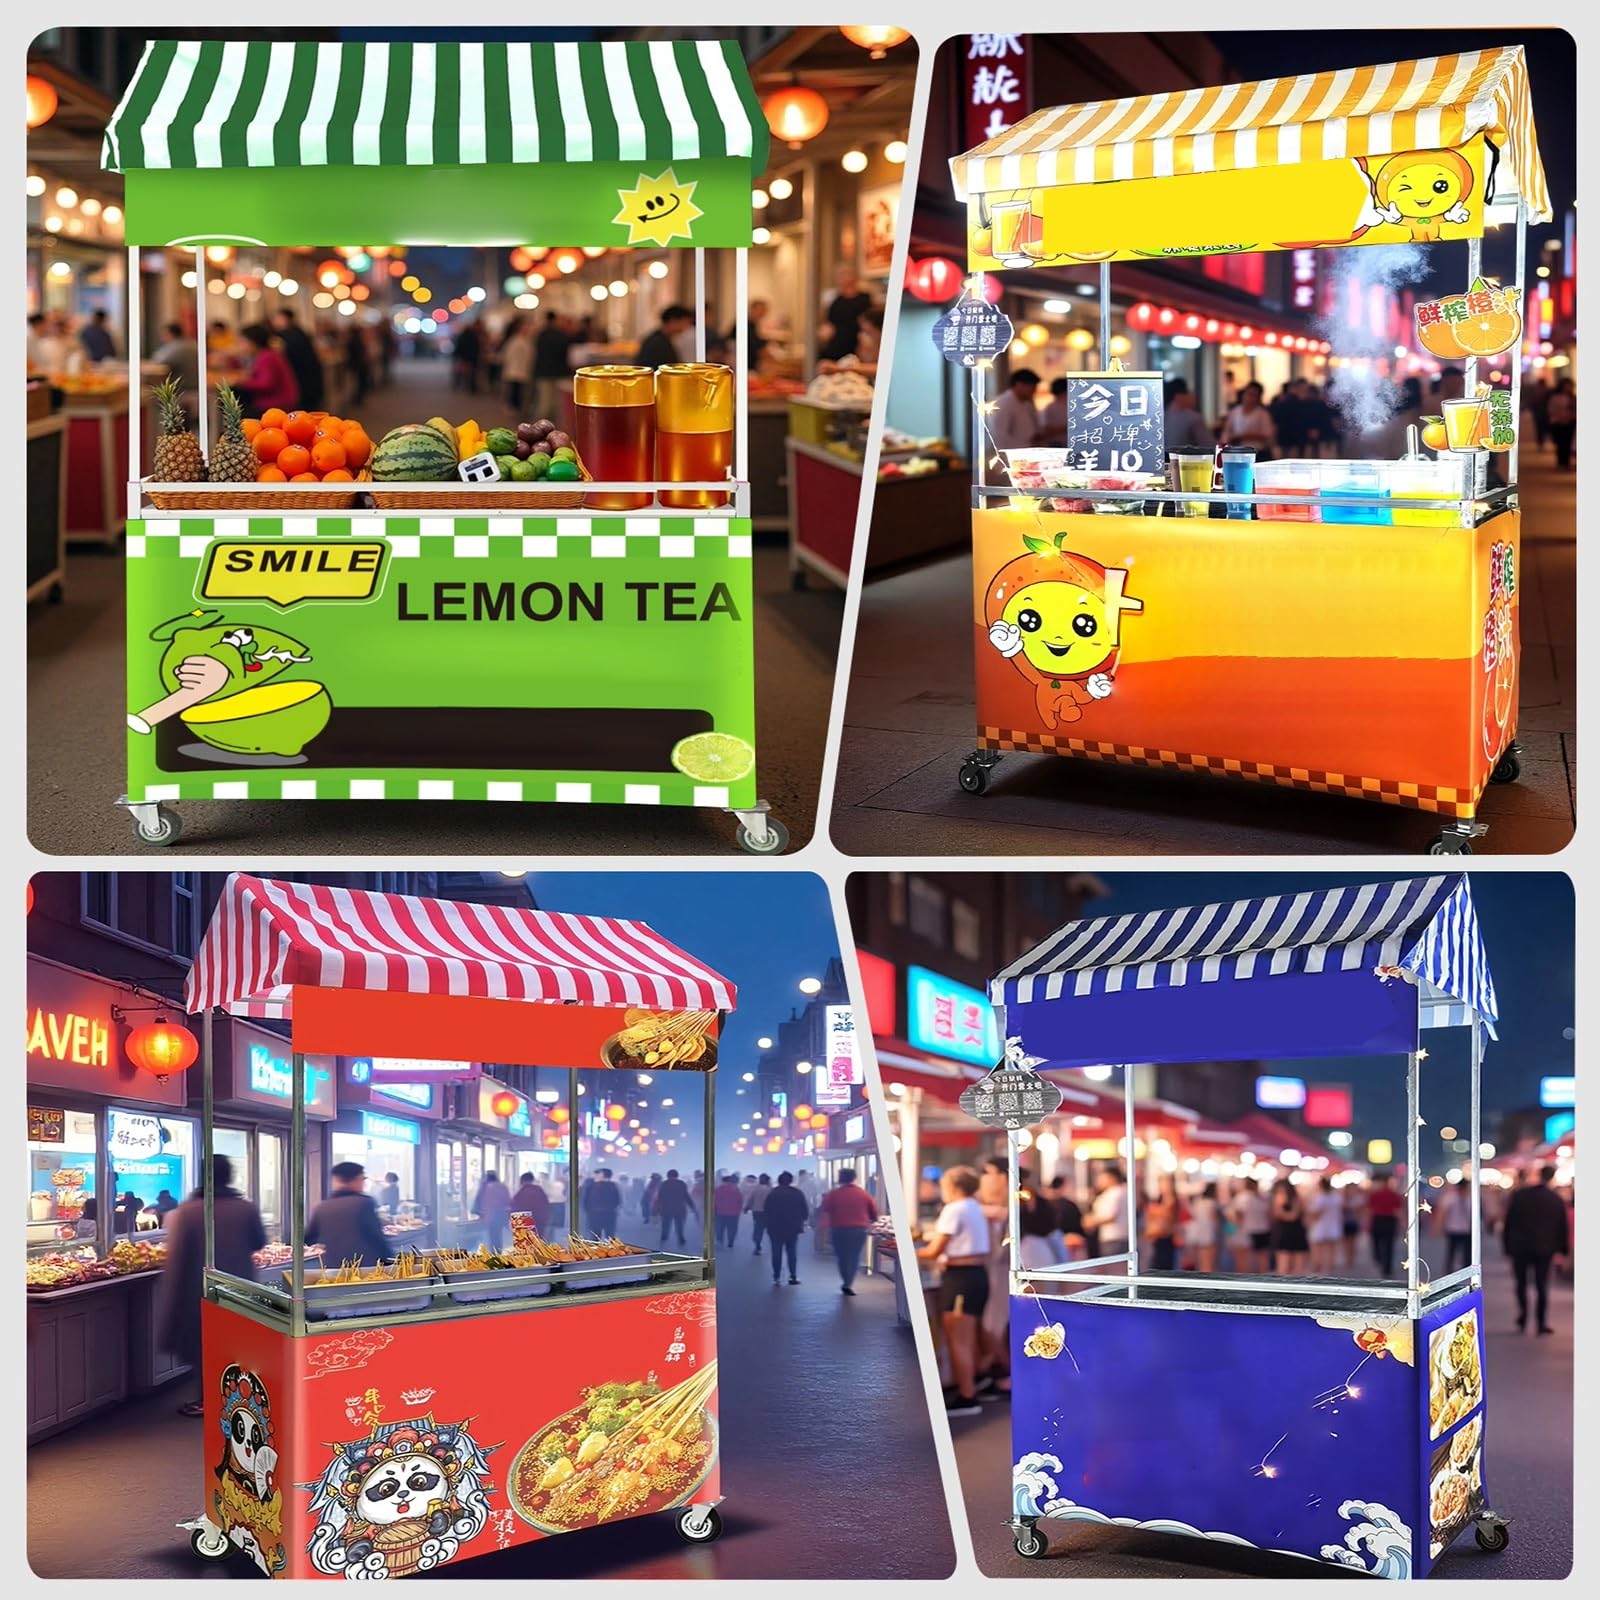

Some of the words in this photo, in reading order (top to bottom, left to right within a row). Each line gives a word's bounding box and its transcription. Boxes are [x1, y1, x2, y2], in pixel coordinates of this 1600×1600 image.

[1078, 384, 1149, 420] 今日
[1490, 390, 1516, 445] 无添加
[1075, 423, 1140, 450] 招牌
[224, 550, 378, 573] SMILE
[398, 581, 603, 622] LEMON
[625, 582, 741, 622] TEA
